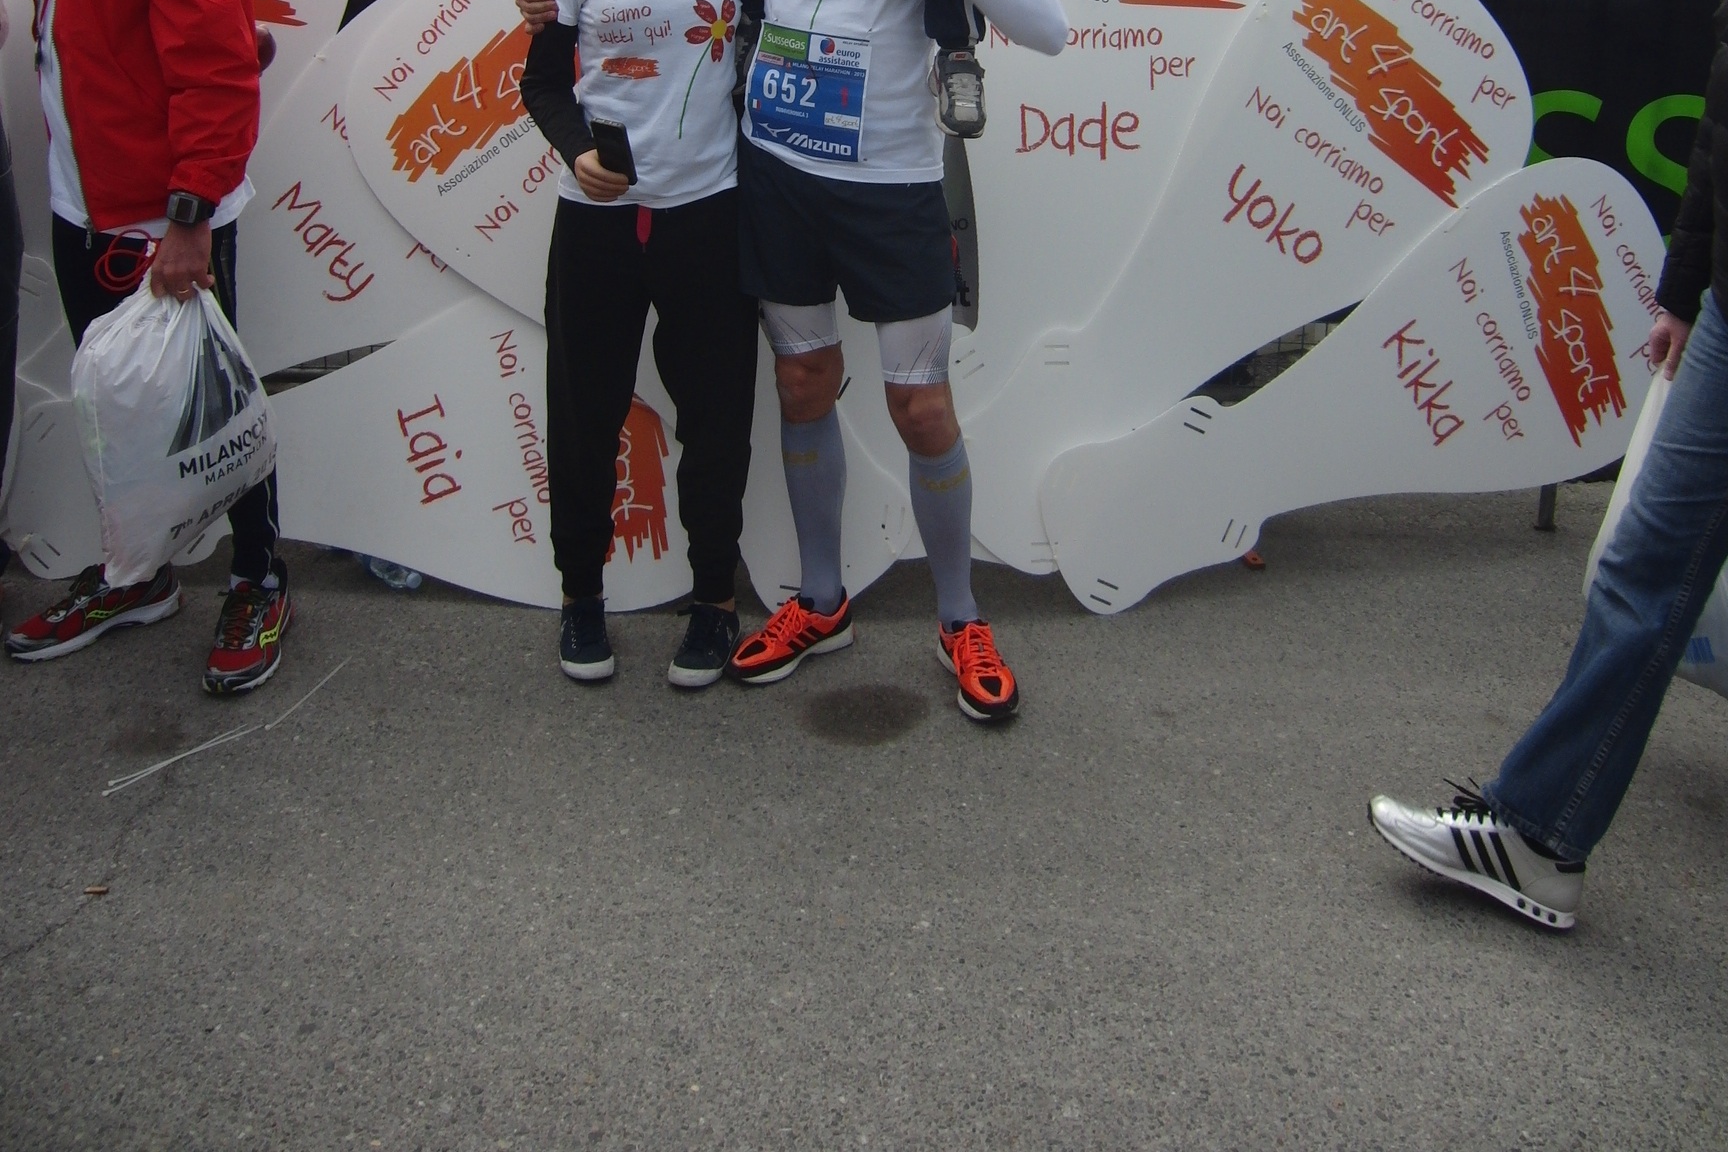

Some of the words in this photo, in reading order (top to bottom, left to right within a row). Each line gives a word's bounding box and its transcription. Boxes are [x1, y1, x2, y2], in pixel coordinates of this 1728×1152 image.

[598, 26, 634, 44] tutti
[644, 20, 673, 45] qui!
[600, 6, 652, 24] Siamo
[1065, 23, 1163, 50] orriamo
[1310, 7, 1368, 64] art
[373, 57, 415, 102] Noi
[819, 56, 860, 67] assistance
[836, 49, 861, 59] europ
[1150, 54, 1196, 90] per
[1367, 44, 1412, 76] 4
[409, 103, 468, 165] art
[453, 59, 482, 110] 4
[763, 69, 817, 108] 652
[1282, 40, 1337, 100] Associazione
[1333, 96, 1366, 134] ONLUS
[1470, 75, 1517, 110] per
[1015, 101, 1141, 161] Dade
[1245, 85, 1292, 130] Noi
[1294, 126, 1384, 194] corriamo
[1370, 87, 1458, 167] sport
[436, 144, 501, 198] Associazione
[499, 114, 538, 149] ONLUS
[474, 194, 520, 242] Noi
[522, 146, 561, 194] corr
[1222, 163, 1324, 264] Yoko
[1345, 199, 1395, 237] per
[1590, 194, 1623, 237] Noi
[271, 181, 375, 302] Marty
[1531, 214, 1576, 273] art
[1500, 230, 1527, 301] Associazione
[1518, 299, 1539, 340] ONLUS
[1558, 267, 1601, 297] 4
[1449, 256, 1484, 303] Noi
[1476, 312, 1531, 402] corriamo
[1548, 308, 1609, 403] sport
[1382, 319, 1465, 446] Kikka
[490, 329, 525, 378] Noi
[508, 392, 551, 504] corriamo
[1483, 401, 1524, 440] per
[492, 497, 537, 544] per
